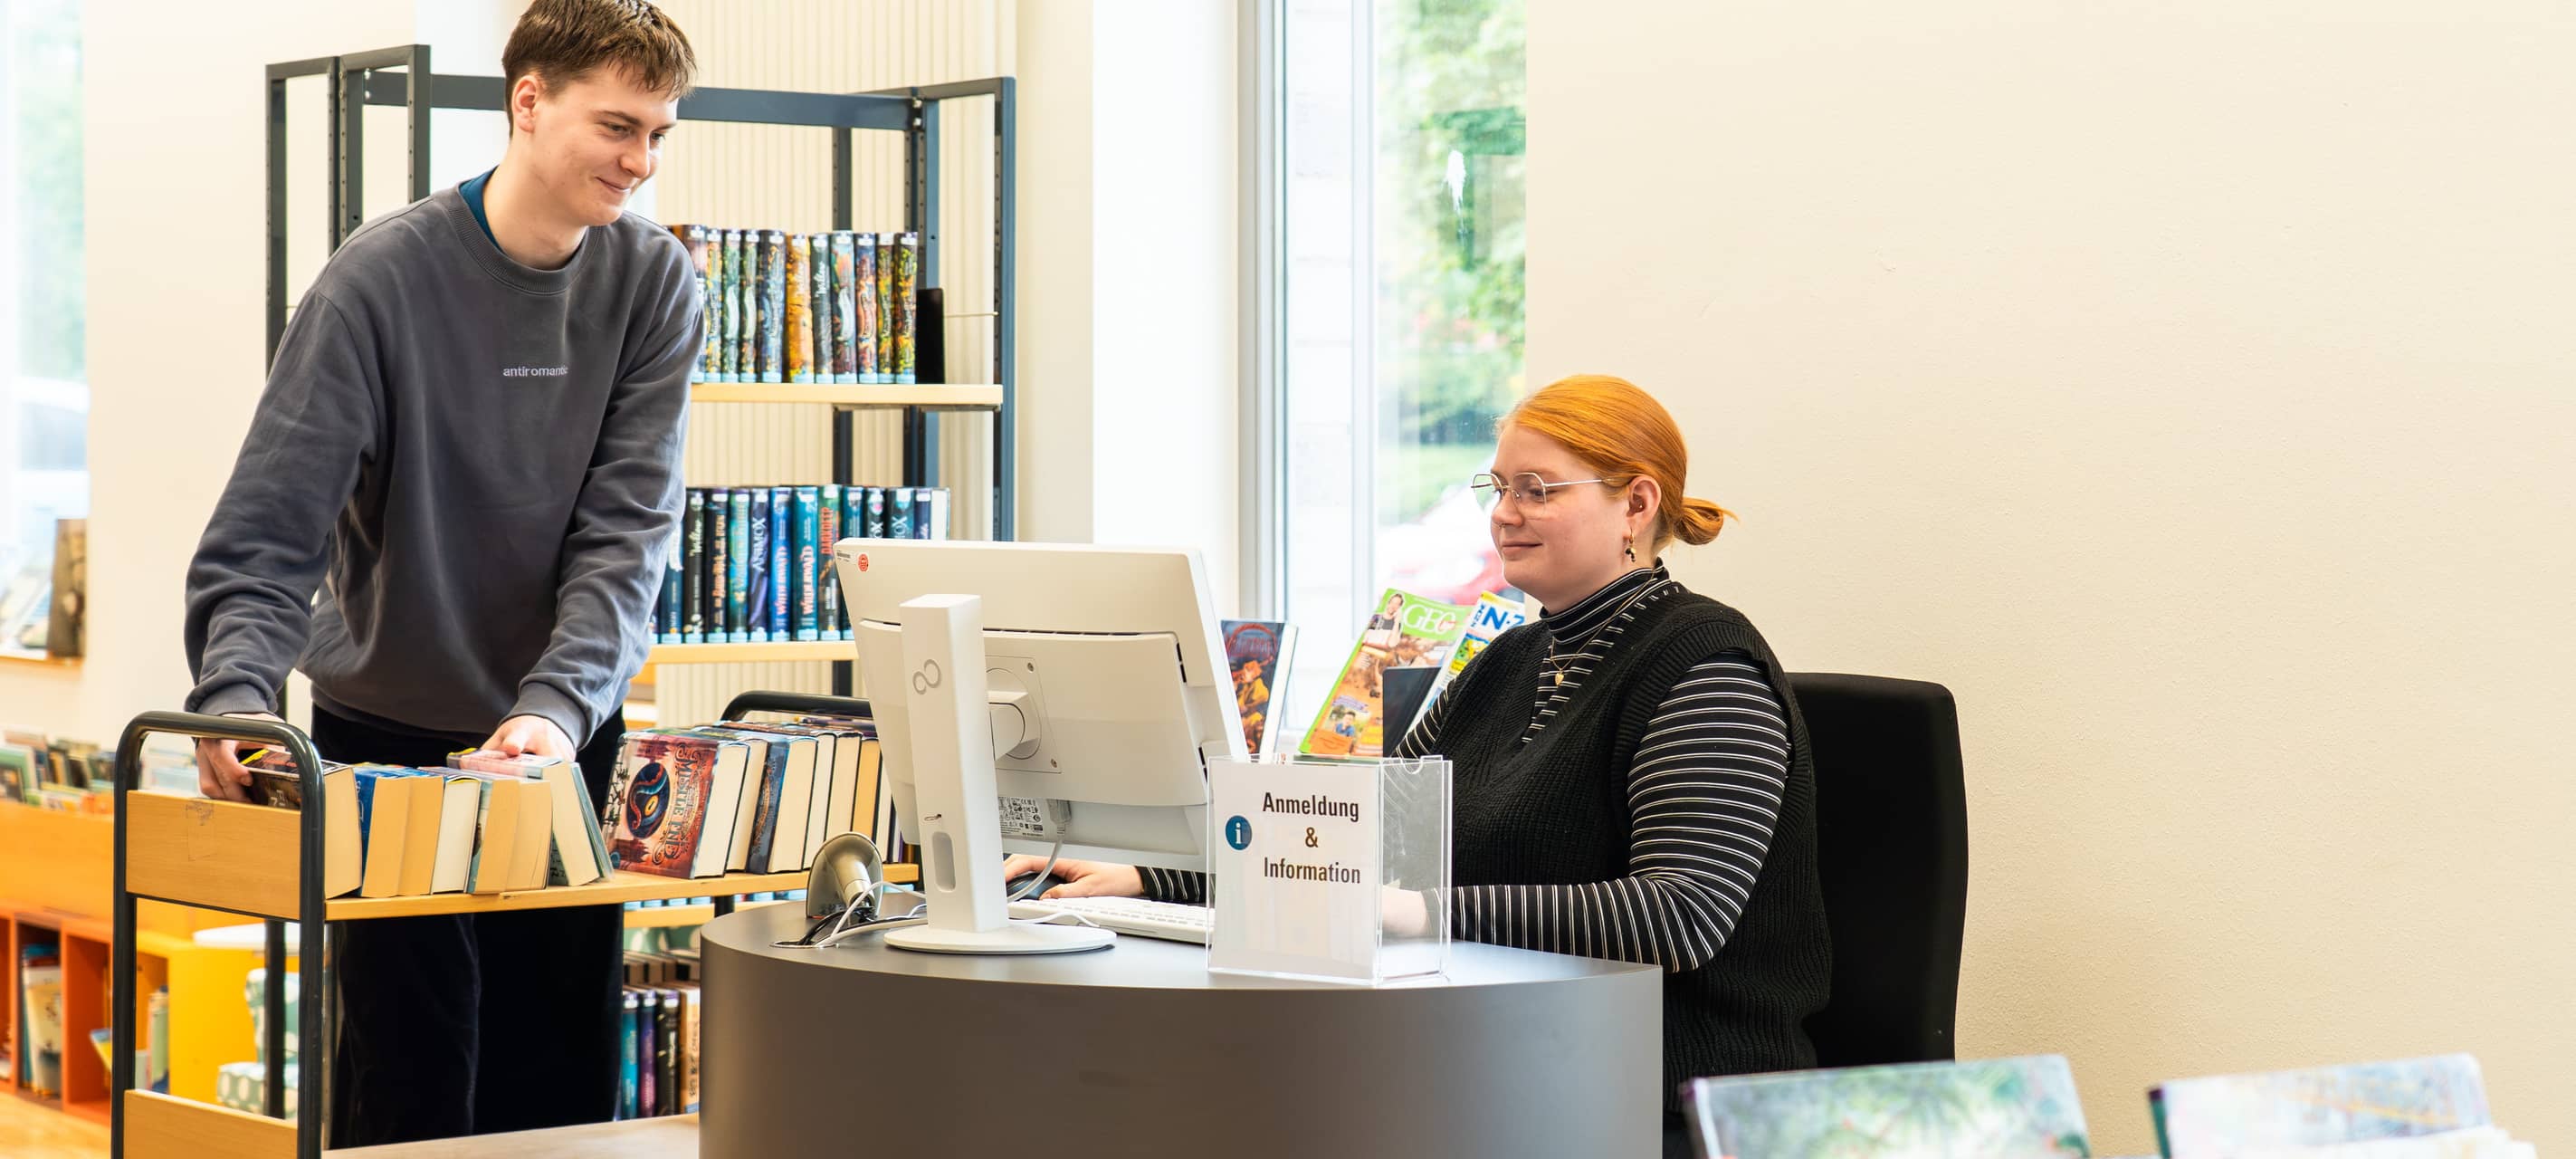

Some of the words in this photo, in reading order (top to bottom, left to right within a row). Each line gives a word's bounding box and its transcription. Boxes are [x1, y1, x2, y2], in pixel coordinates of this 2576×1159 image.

[813, 261, 827, 298] Willow
[688, 519, 703, 557] Willow
[1263, 791, 1360, 823] Anmeldung
[1304, 826, 1319, 848] &
[1264, 857, 1360, 884] Information
